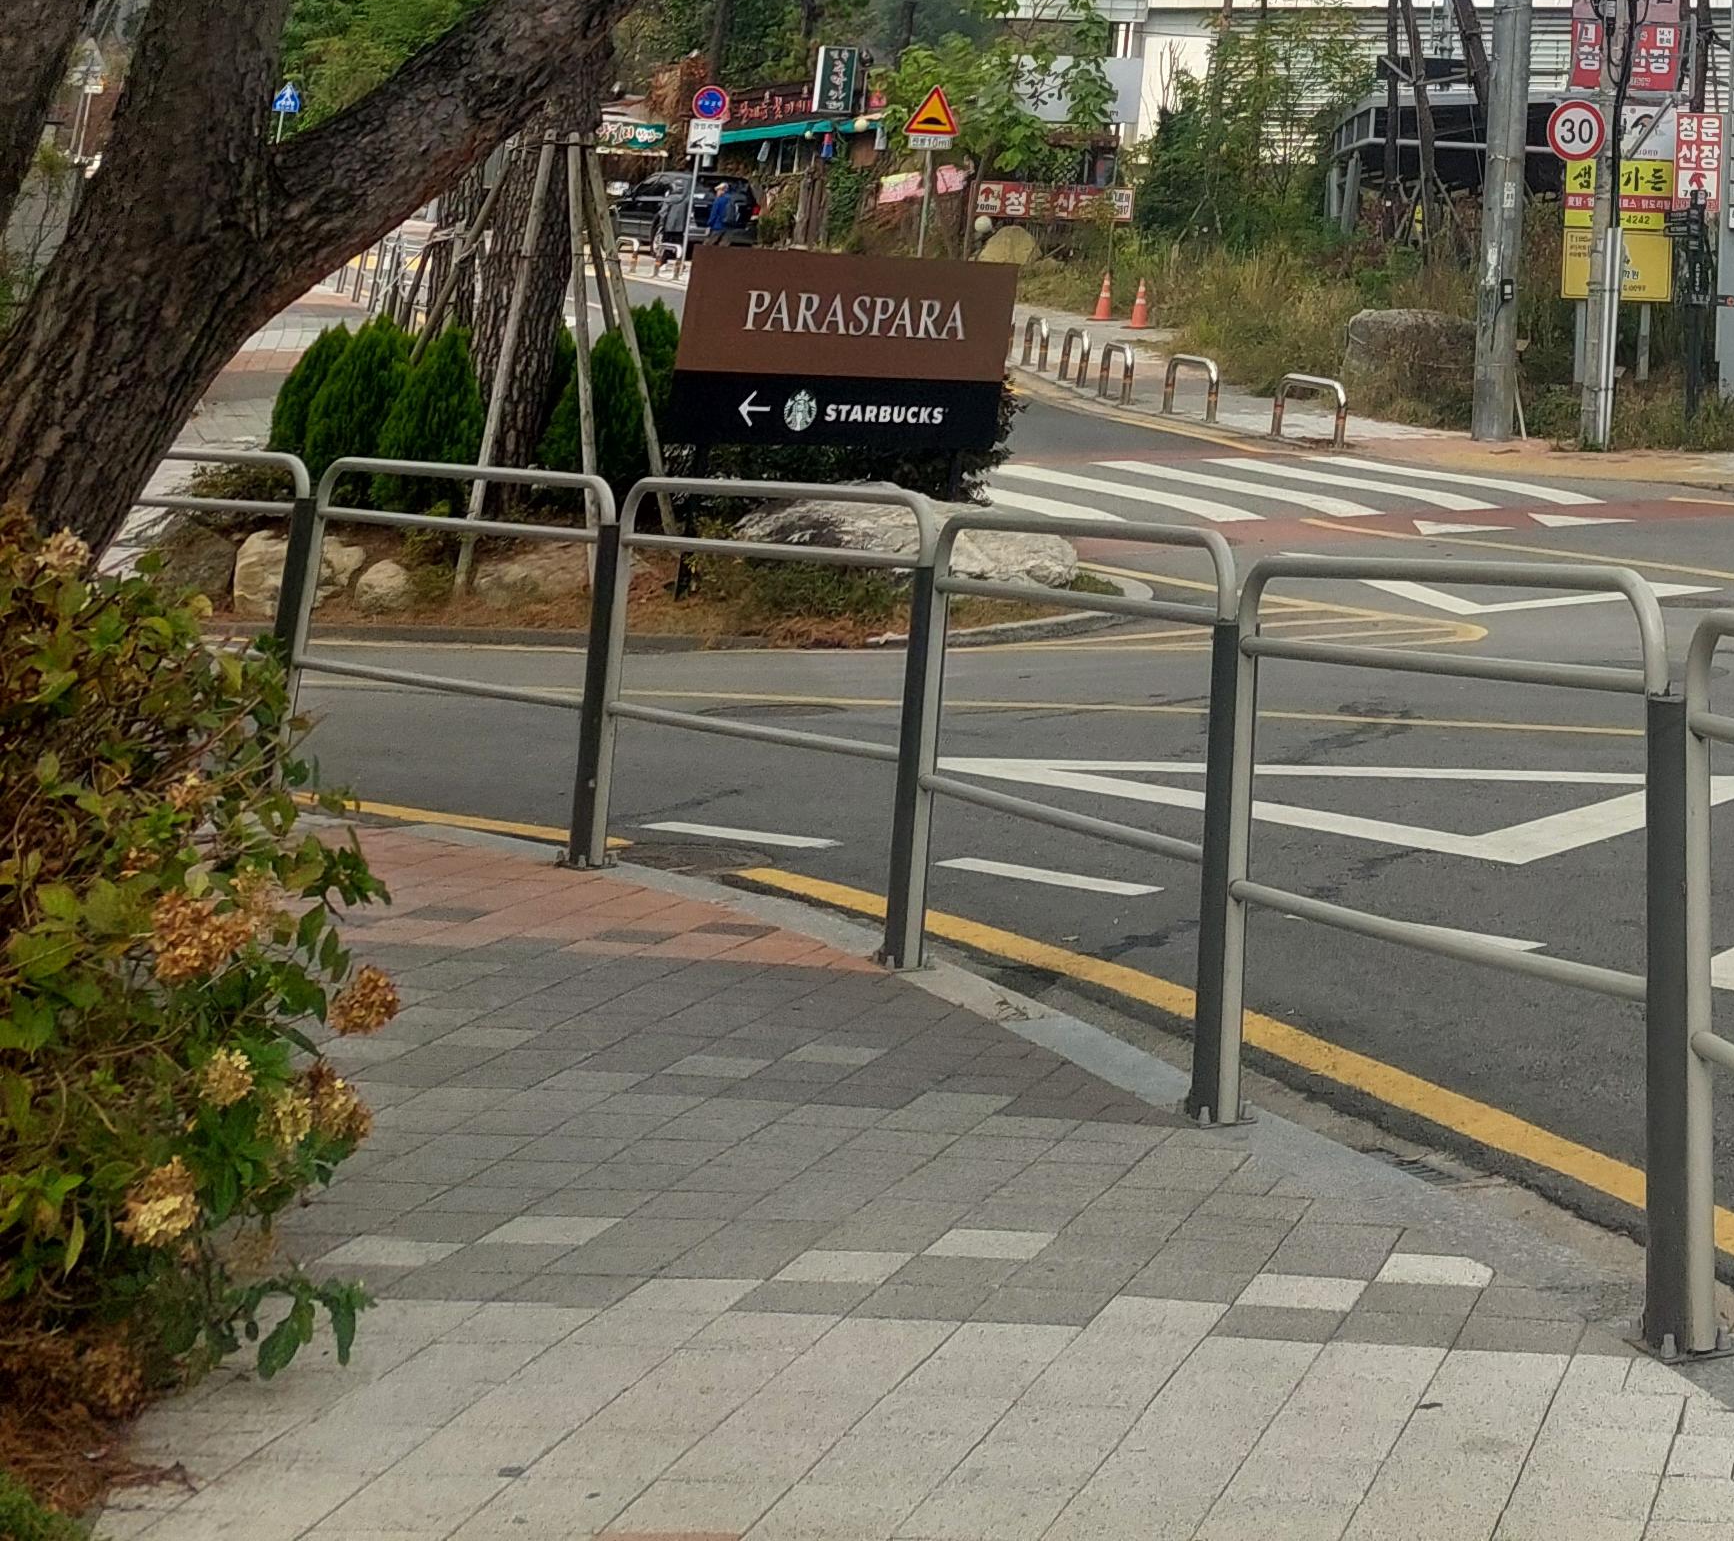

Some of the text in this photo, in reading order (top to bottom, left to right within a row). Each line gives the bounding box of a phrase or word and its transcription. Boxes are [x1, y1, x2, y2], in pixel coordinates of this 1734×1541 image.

[1561, 118, 1593, 144] 30
[1679, 116, 1720, 142] 청운
[1678, 144, 1720, 169] 산장
[741, 290, 966, 341] PARASPARA
[824, 403, 945, 425] STARBUCKS
